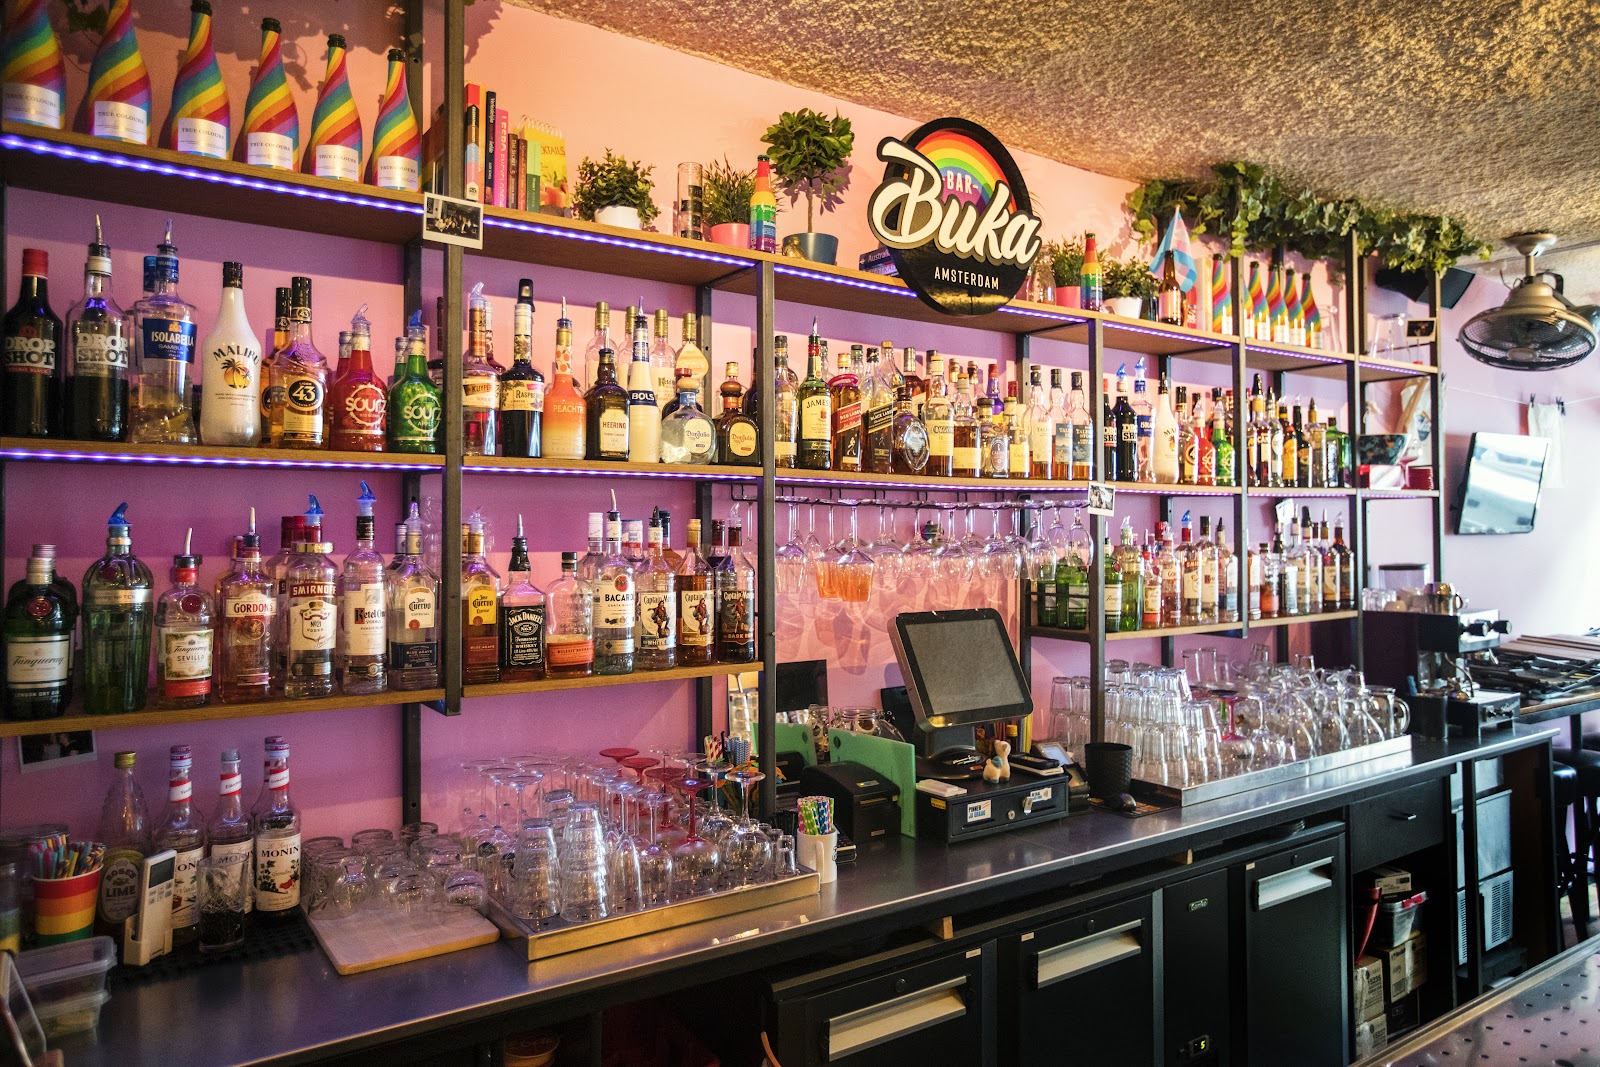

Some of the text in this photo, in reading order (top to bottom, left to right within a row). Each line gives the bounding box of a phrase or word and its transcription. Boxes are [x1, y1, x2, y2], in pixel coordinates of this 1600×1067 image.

[116, 112, 146, 125] COLOURS
[199, 128, 226, 140] COLOURS
[872, 140, 1041, 264] Buka
[934, 266, 999, 290] AMSTERDAM
[5, 336, 56, 352] DROP
[77, 333, 129, 351] DROP
[151, 331, 194, 347] ISOLABELLA
[5, 350, 55, 366] SHOT
[78, 348, 128, 365] SHOT
[212, 345, 260, 366] MALIBU
[292, 385, 316, 402] 43
[631, 392, 655, 401] BOLS
[602, 421, 627, 430] HEERING
[292, 584, 337, 596] SMIRNOFF
[723, 591, 742, 601] Captain
[472, 598, 494, 609] Cuervo
[643, 595, 662, 605] Captain
[684, 593, 703, 603] Captain
[408, 601, 432, 612] Cuervo
[355, 608, 377, 623] Ketel
[508, 614, 522, 627] JACK
[173, 645, 208, 653] Tanqueray
[13, 655, 64, 668] Tanqueray
[261, 846, 299, 858] MONIN
[106, 868, 137, 881] ROSE'S
[105, 885, 136, 898] LIME
[1200, 1040, 1206, 1050] 5
